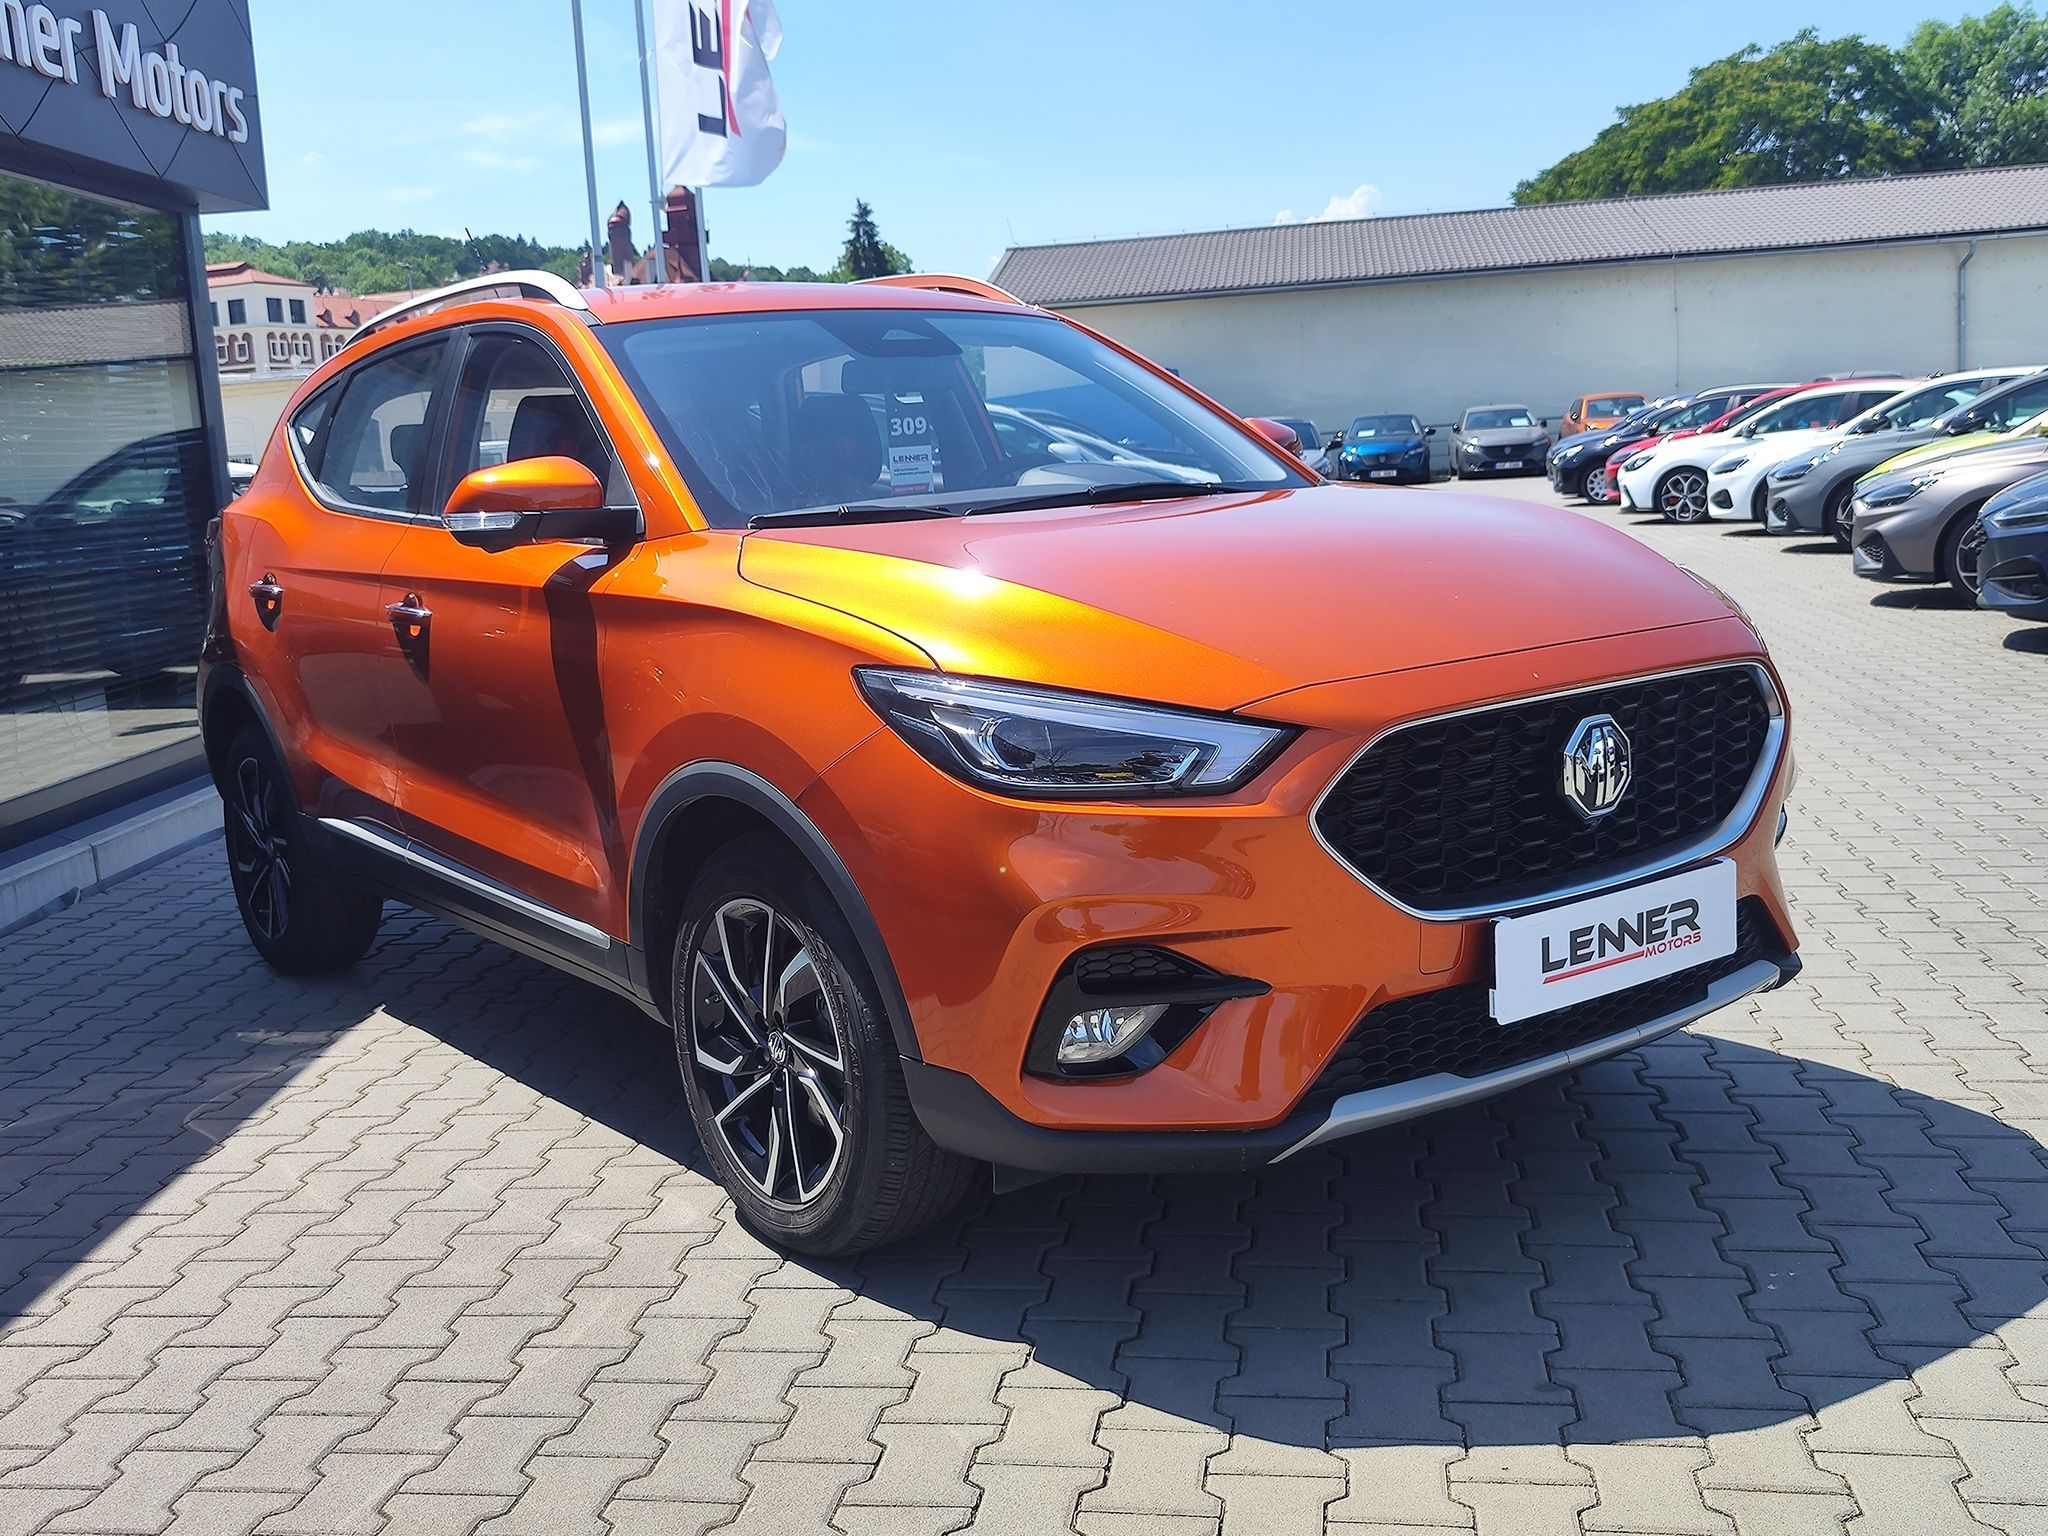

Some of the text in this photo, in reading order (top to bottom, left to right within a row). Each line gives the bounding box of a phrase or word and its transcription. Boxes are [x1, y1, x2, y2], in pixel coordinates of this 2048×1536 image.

[91, 9, 249, 144] Motors
[890, 416, 927, 436] 309
[892, 454, 929, 463] LENNER
[1574, 724, 1629, 808] MG
[1541, 898, 1701, 974] LENNER
[1644, 931, 1702, 958] MOTORS
